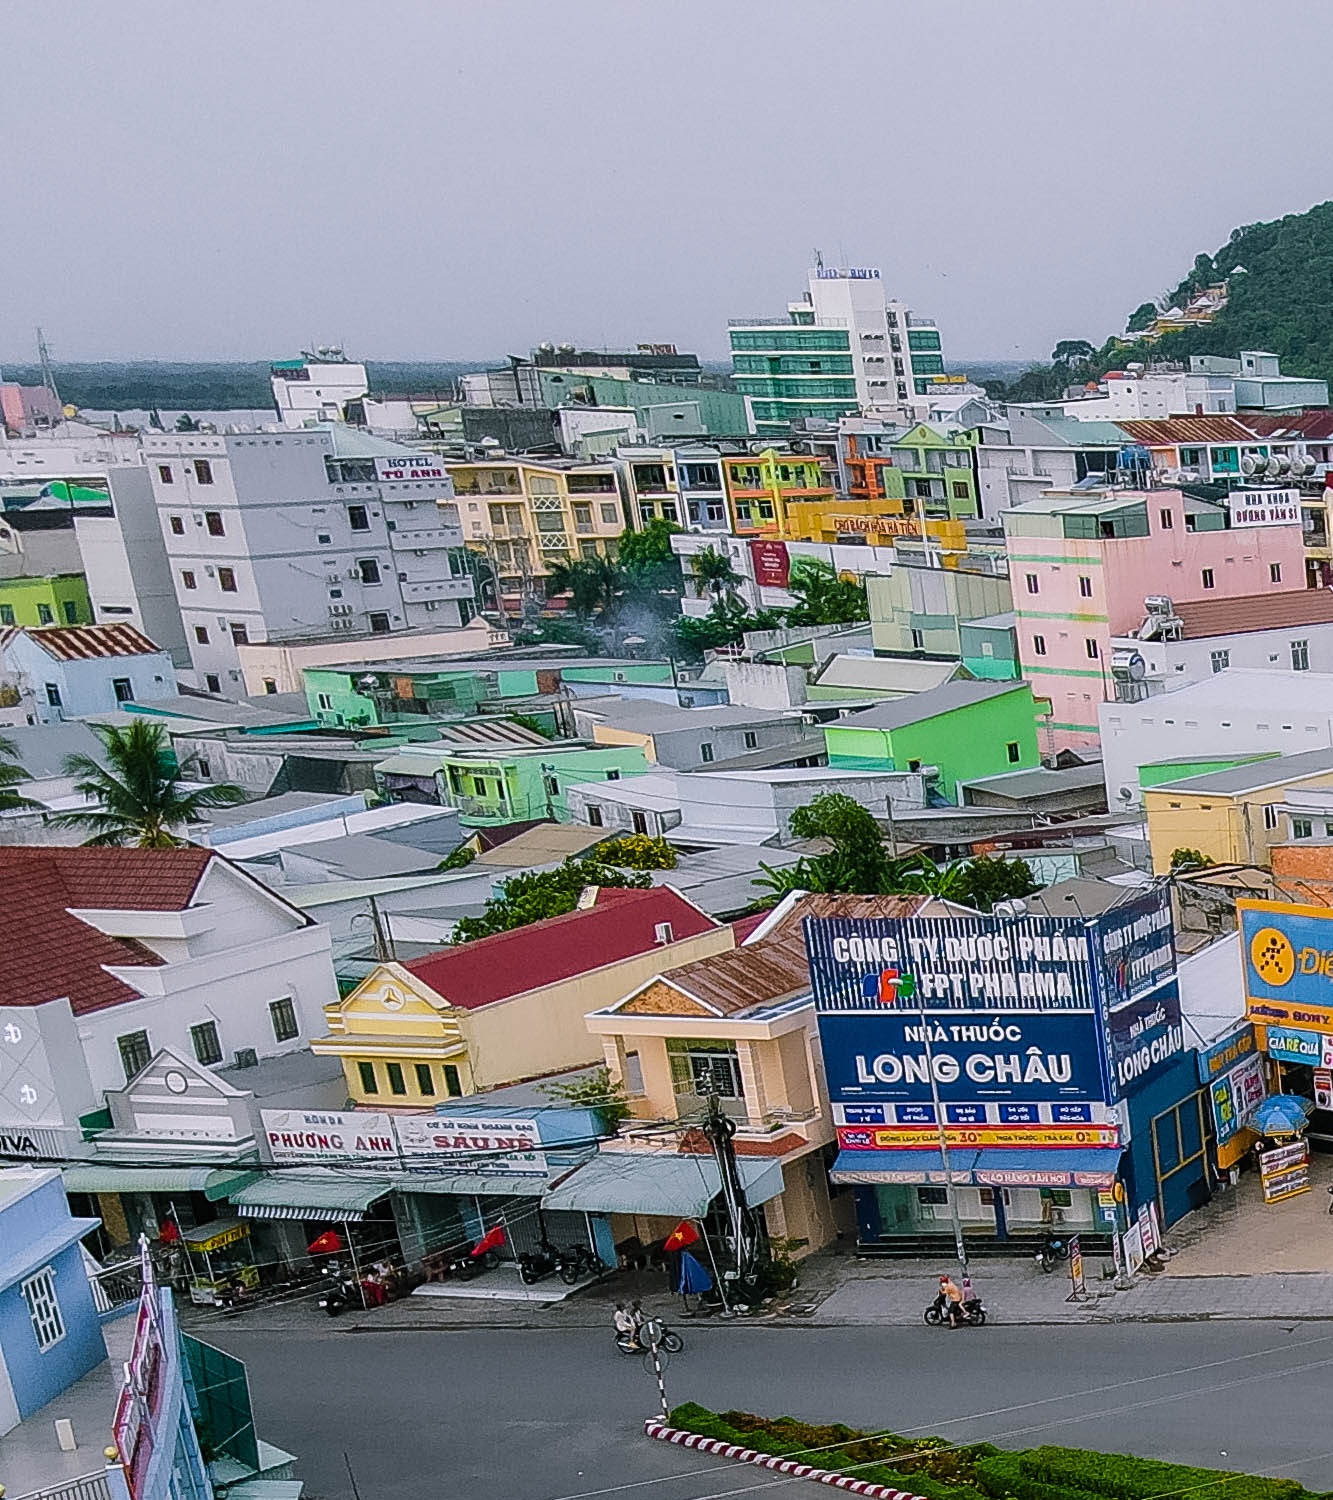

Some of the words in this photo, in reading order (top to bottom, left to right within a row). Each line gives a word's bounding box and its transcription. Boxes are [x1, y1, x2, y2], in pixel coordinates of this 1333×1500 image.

[388, 457, 433, 468] HOTEL
[833, 932, 899, 962] CÔNG
[911, 937, 939, 961] TY
[922, 973, 967, 999] FPT
[971, 972, 1074, 999] PHARMA
[1293, 1010, 1331, 1025] SONY
[905, 1020, 949, 1042] NHÀ
[951, 1017, 1023, 1042] THUỐC
[855, 1055, 961, 1084] LONG
[965, 1046, 1072, 1085] CHÂU
[1117, 1046, 1151, 1087] LONG
[1150, 1025, 1183, 1065] CHÂU
[304, 1115, 344, 1126] HONDA
[0, 1135, 39, 1152] IVA
[268, 1131, 344, 1150] PHƯƠNG
[355, 1136, 393, 1152] ANH
[433, 1132, 490, 1151] SÁU
